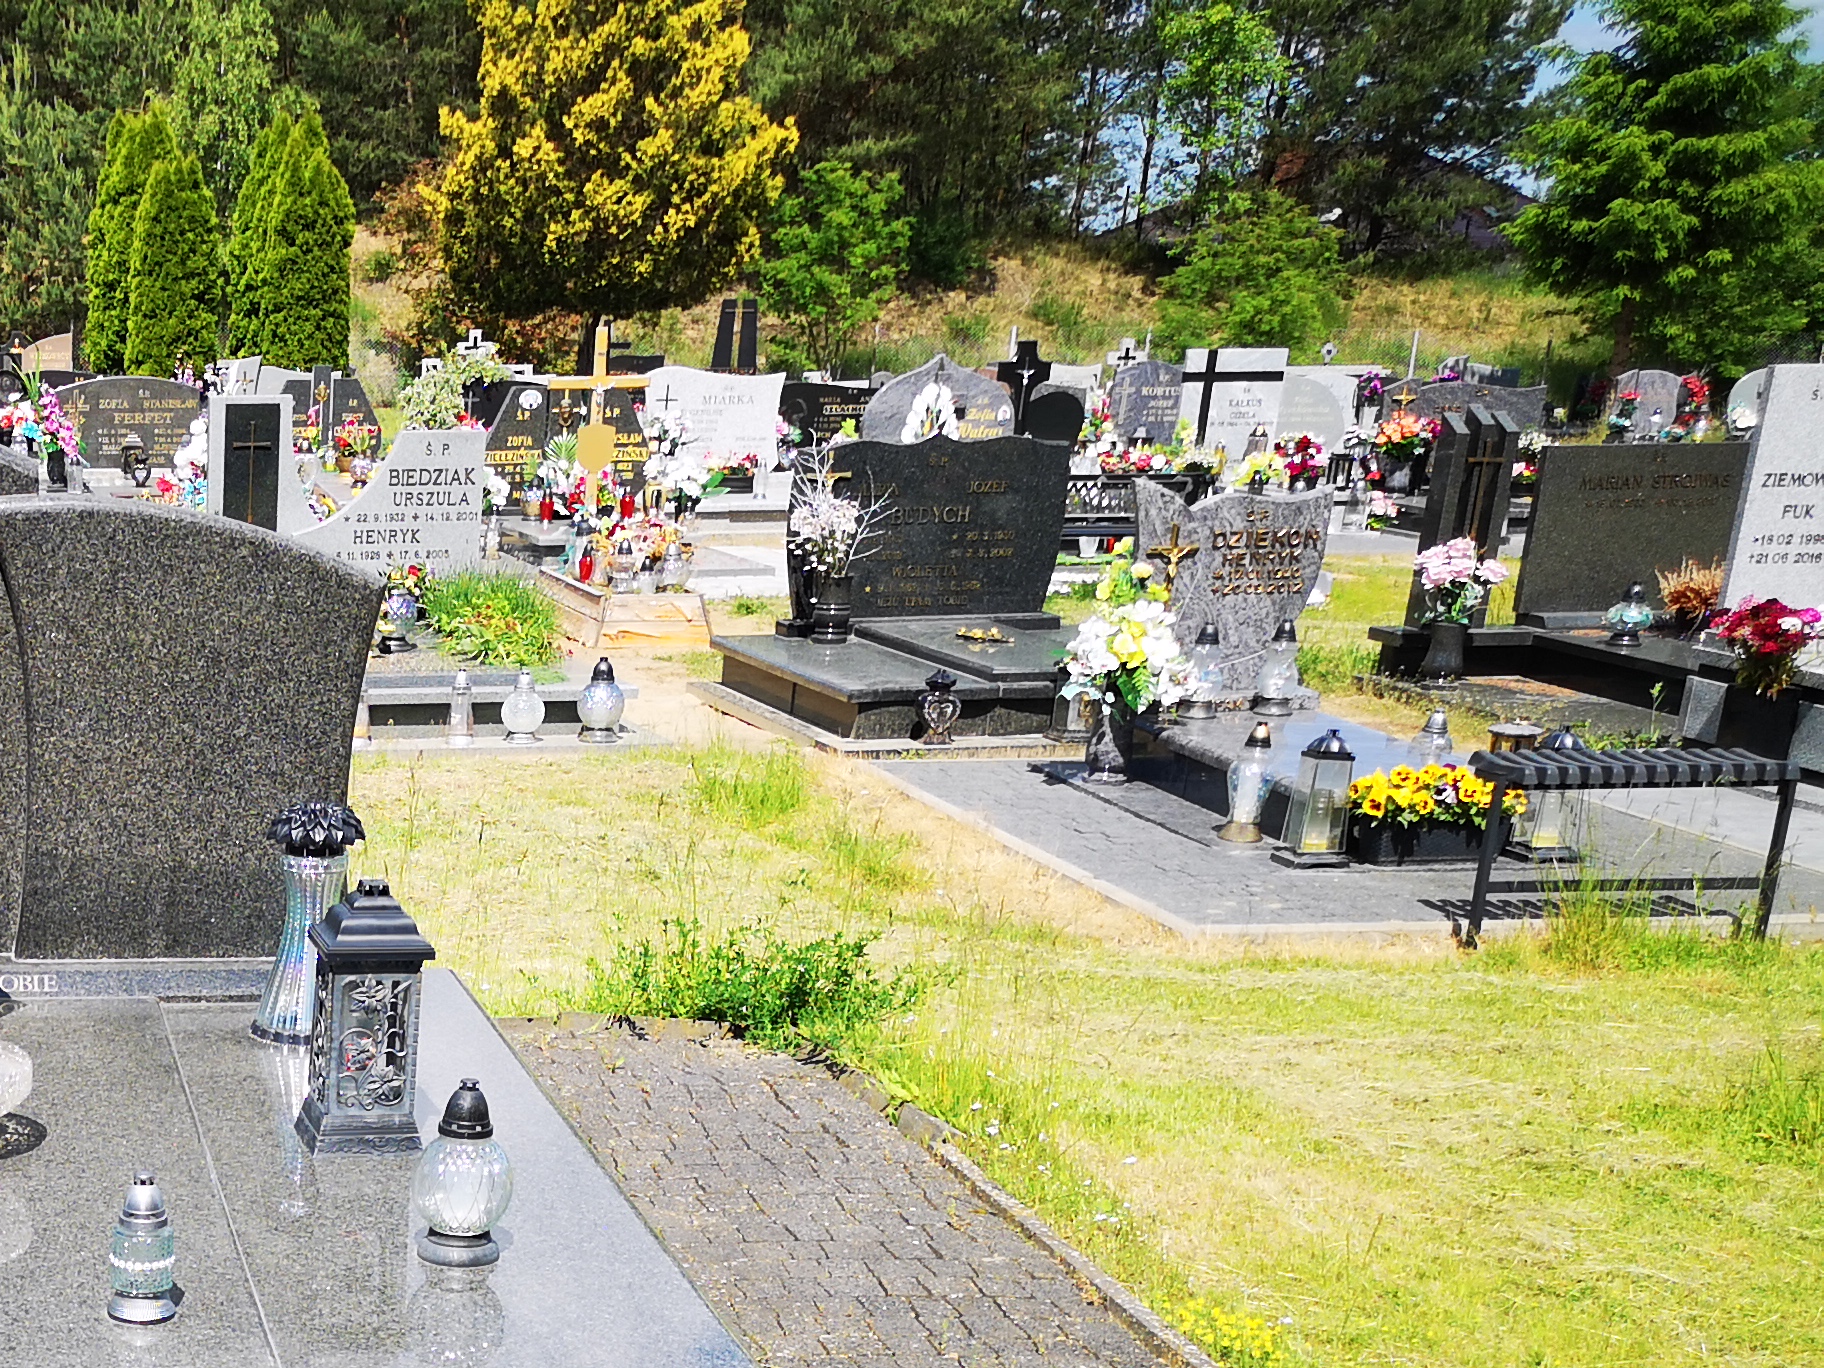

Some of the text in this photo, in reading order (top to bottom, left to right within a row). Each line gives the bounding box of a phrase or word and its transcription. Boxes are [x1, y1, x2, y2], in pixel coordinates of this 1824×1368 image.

[98, 399, 129, 409] ZOFIA
[702, 395, 755, 406] MIARKA
[113, 412, 175, 424] FERFET
[506, 435, 533, 447] ZOFIA
[388, 467, 476, 487] BIEDZIAK
[393, 491, 470, 507] URSZULA
[890, 506, 972, 526] BUDYCH
[1781, 504, 1816, 520] FUK
[352, 528, 421, 545] HENRYK
